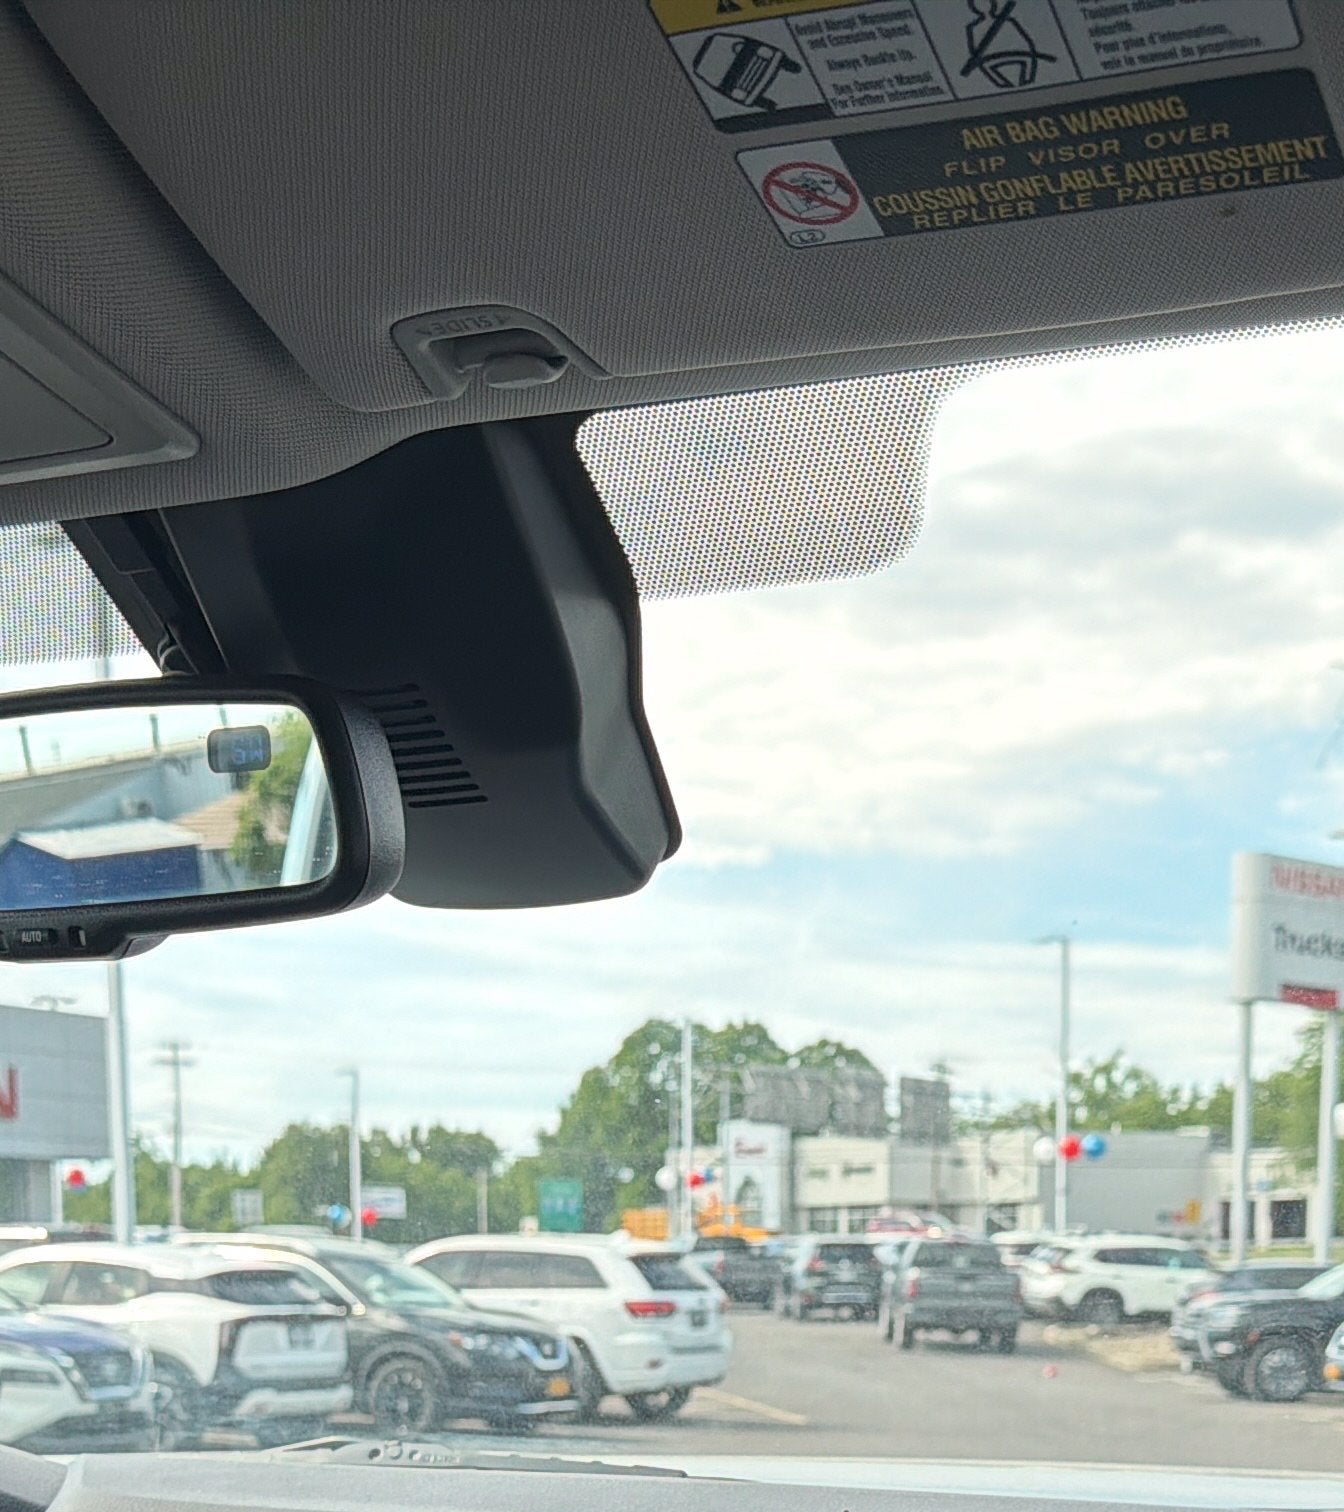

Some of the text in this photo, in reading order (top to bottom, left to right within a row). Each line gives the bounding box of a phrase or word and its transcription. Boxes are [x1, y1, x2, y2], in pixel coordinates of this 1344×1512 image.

[808, 37, 828, 49] and
[826, 54, 863, 72] Always
[944, 121, 1232, 179] FLIP VISOR OVER
[962, 96, 1189, 152] AIR BAG WARNING
[872, 134, 1329, 219] COUSSIN GONFLABLE AVERTISSEMENT
[913, 162, 1312, 231] REPLIER LE PARESOLEIL
[21, 930, 42, 943] AUTO
